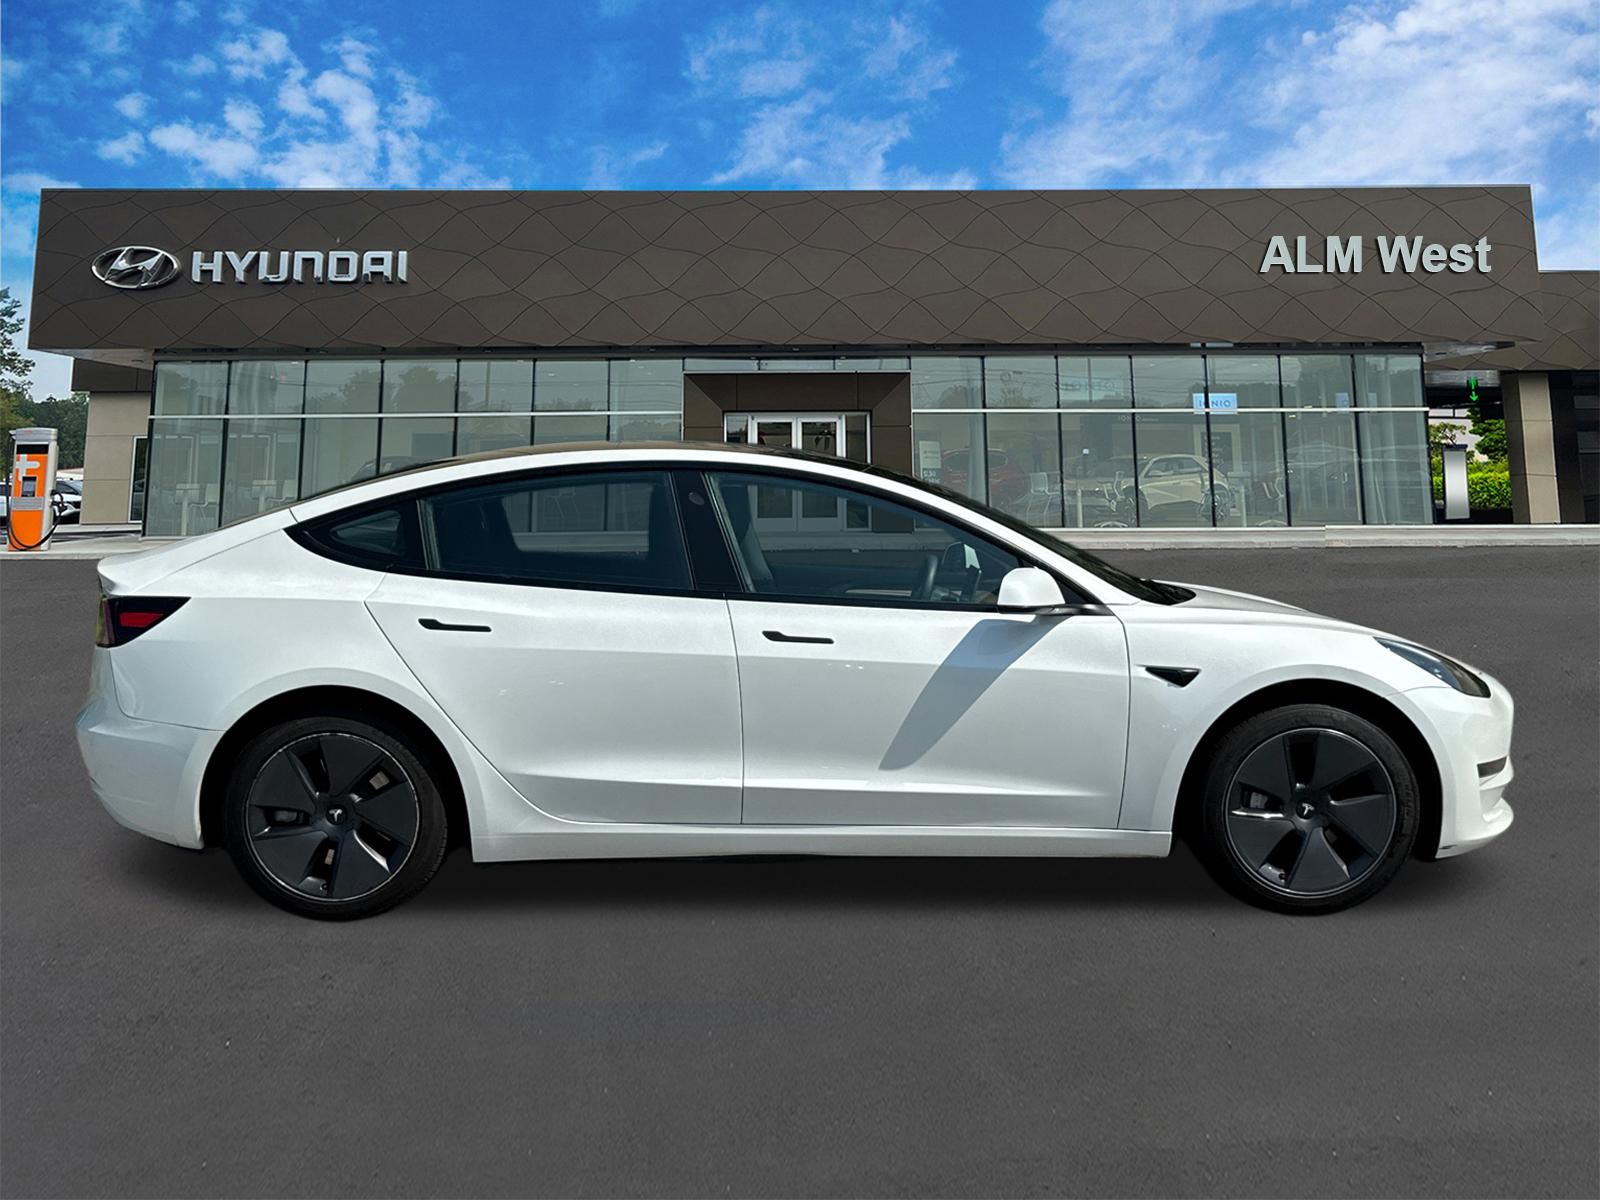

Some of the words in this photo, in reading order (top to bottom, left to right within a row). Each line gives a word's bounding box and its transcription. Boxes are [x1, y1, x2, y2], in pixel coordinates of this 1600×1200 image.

[191, 251, 408, 283] HYUNDAI
[1259, 235, 1363, 273] ALM
[1377, 235, 1492, 273] West
